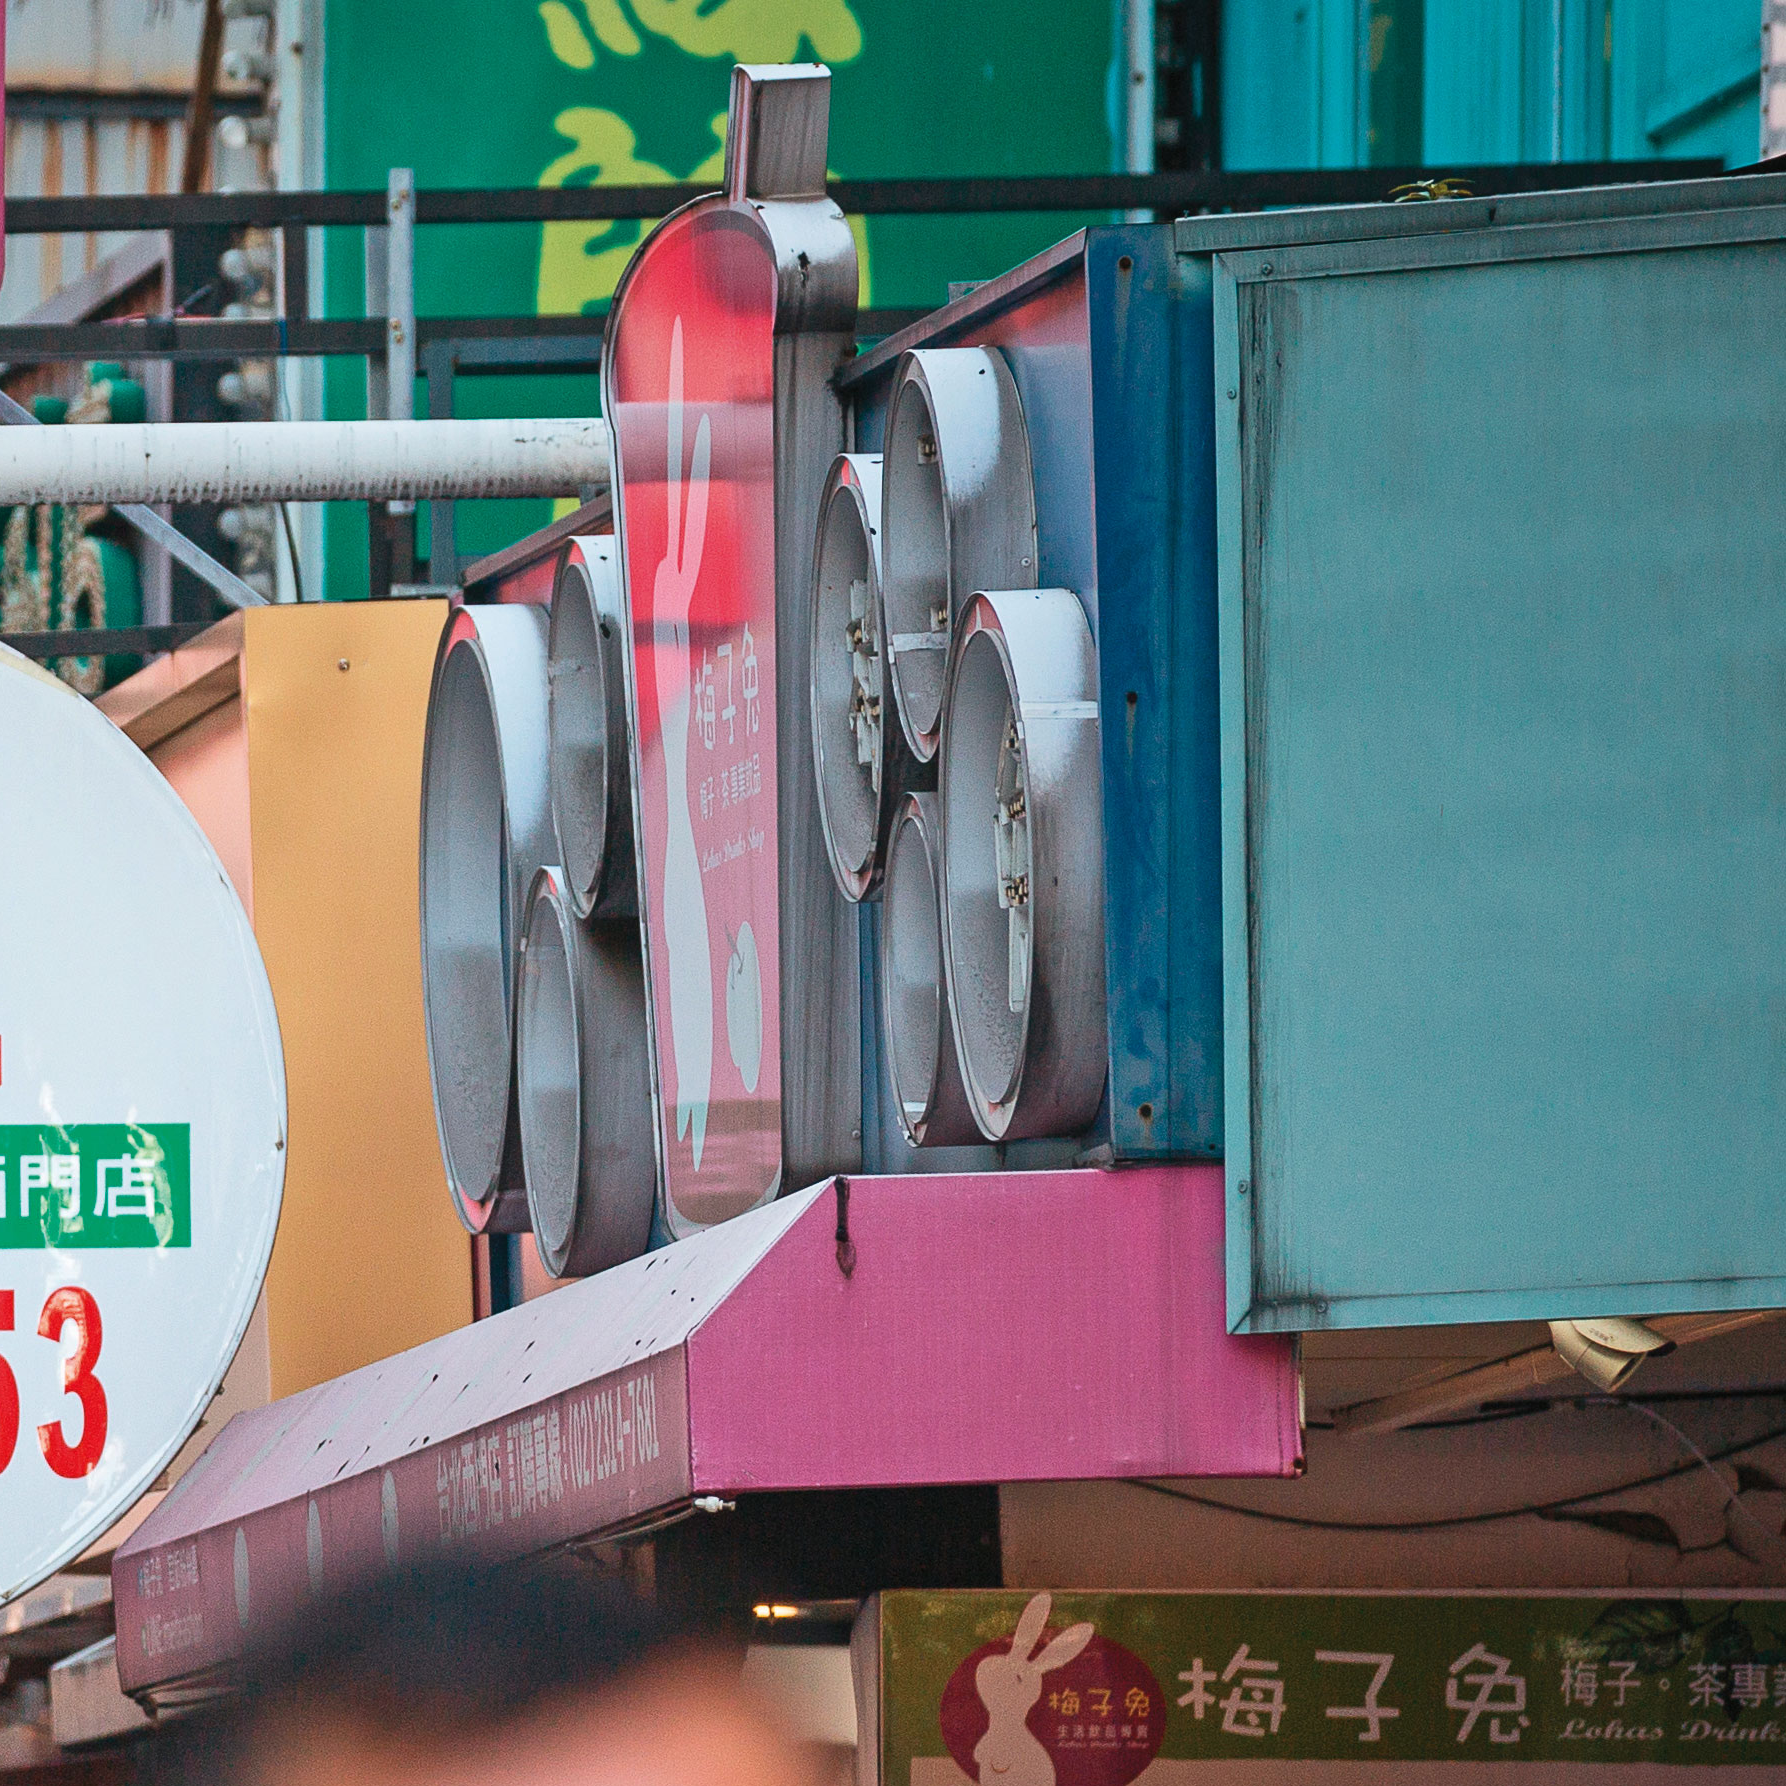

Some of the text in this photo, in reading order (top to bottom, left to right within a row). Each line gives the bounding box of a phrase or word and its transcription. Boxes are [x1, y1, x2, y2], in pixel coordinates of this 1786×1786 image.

[695, 621, 760, 750] 梅子兔
[1049, 1687, 1150, 1718] 梅子兔
[1177, 1643, 1530, 1744] 梅子兔
[1558, 1717, 1664, 1742] Lohas
